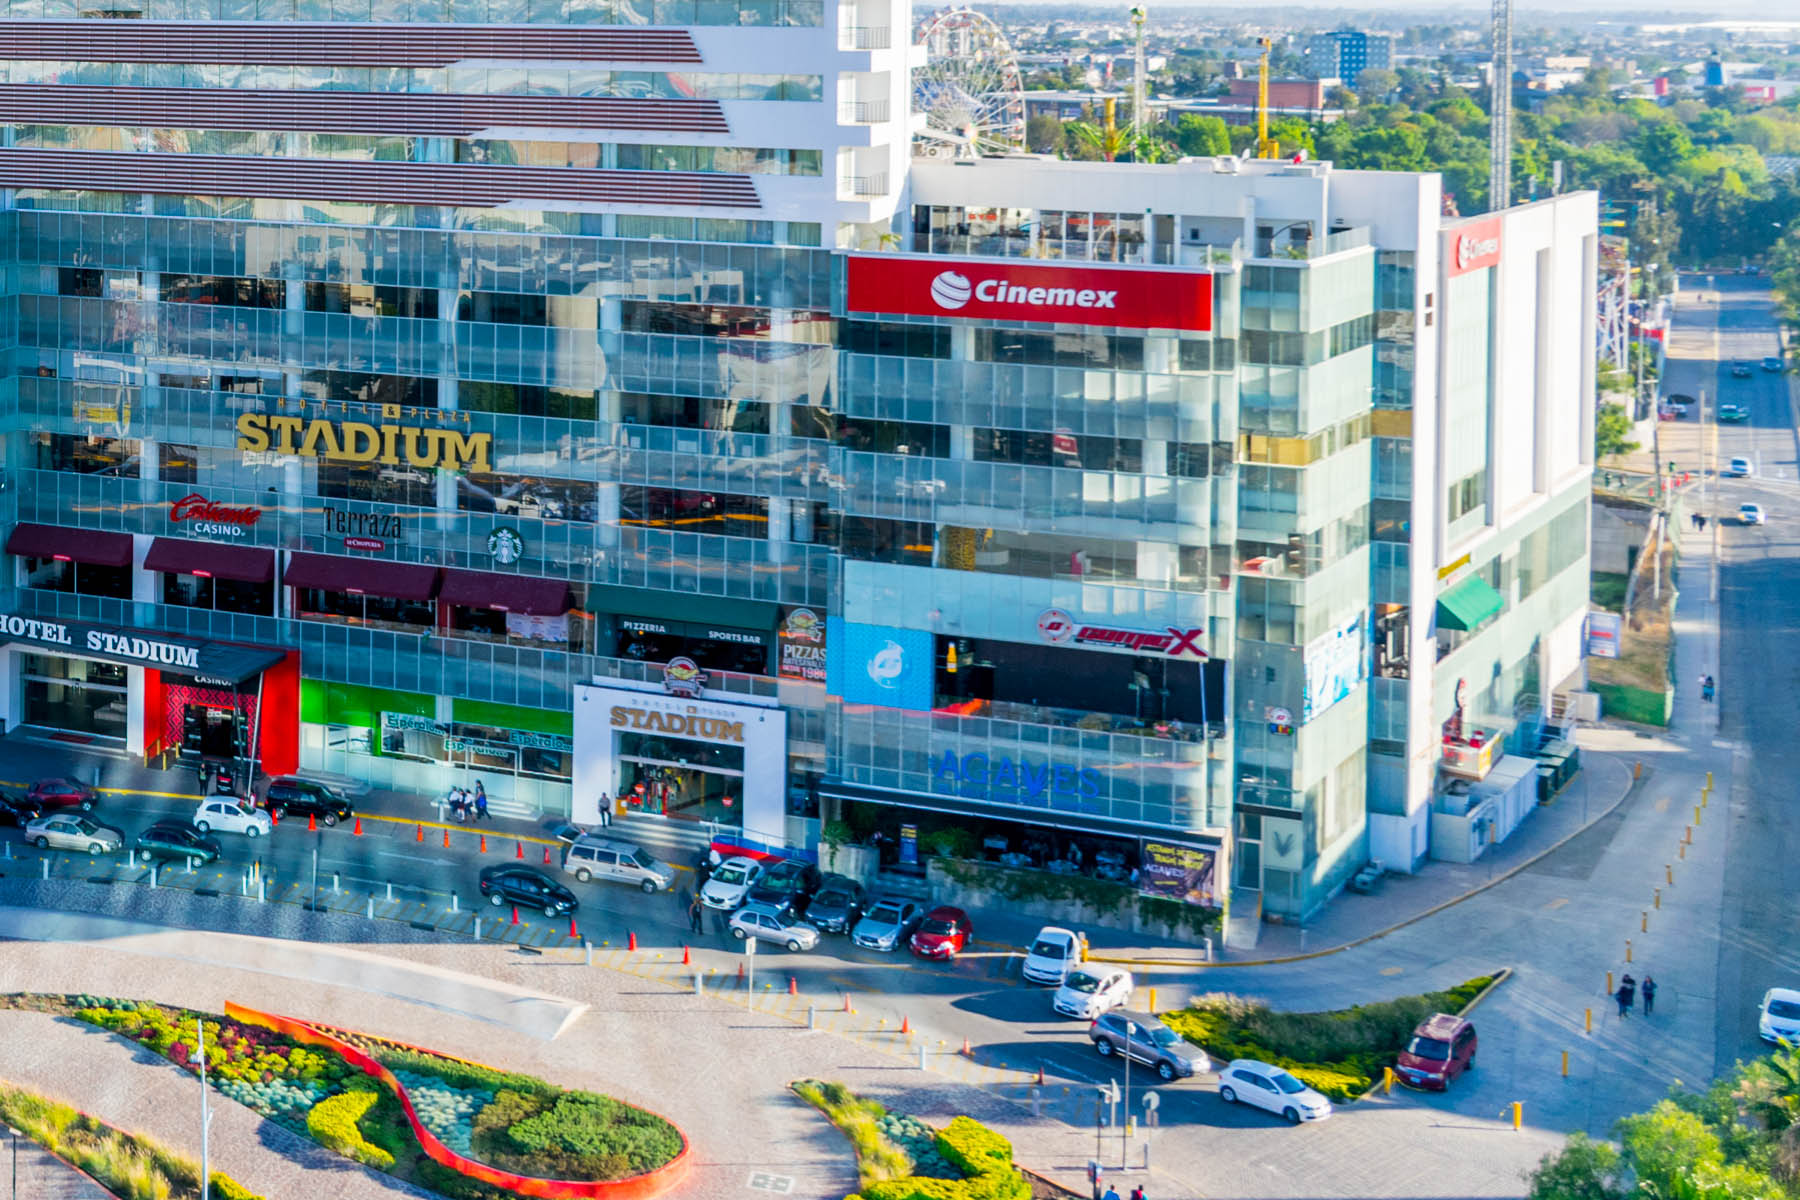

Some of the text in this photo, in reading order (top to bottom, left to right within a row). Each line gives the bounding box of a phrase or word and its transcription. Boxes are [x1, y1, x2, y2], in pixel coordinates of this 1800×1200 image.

[975, 279, 1118, 309] Cinemex
[278, 397, 368, 415] HOTEL
[411, 407, 471, 423] PLAZA
[236, 413, 493, 473] STADIUM
[170, 492, 262, 526] Caliente
[323, 507, 402, 539] Terraza
[194, 522, 241, 537] CASINO
[623, 620, 666, 634] PIZZERIA
[708, 630, 761, 644] SPORTS BAR
[86, 629, 200, 669] STADIUM
[783, 644, 827, 661] PIZZAS
[609, 705, 745, 742] STADIUM
[936, 749, 1101, 799] AGAVES
